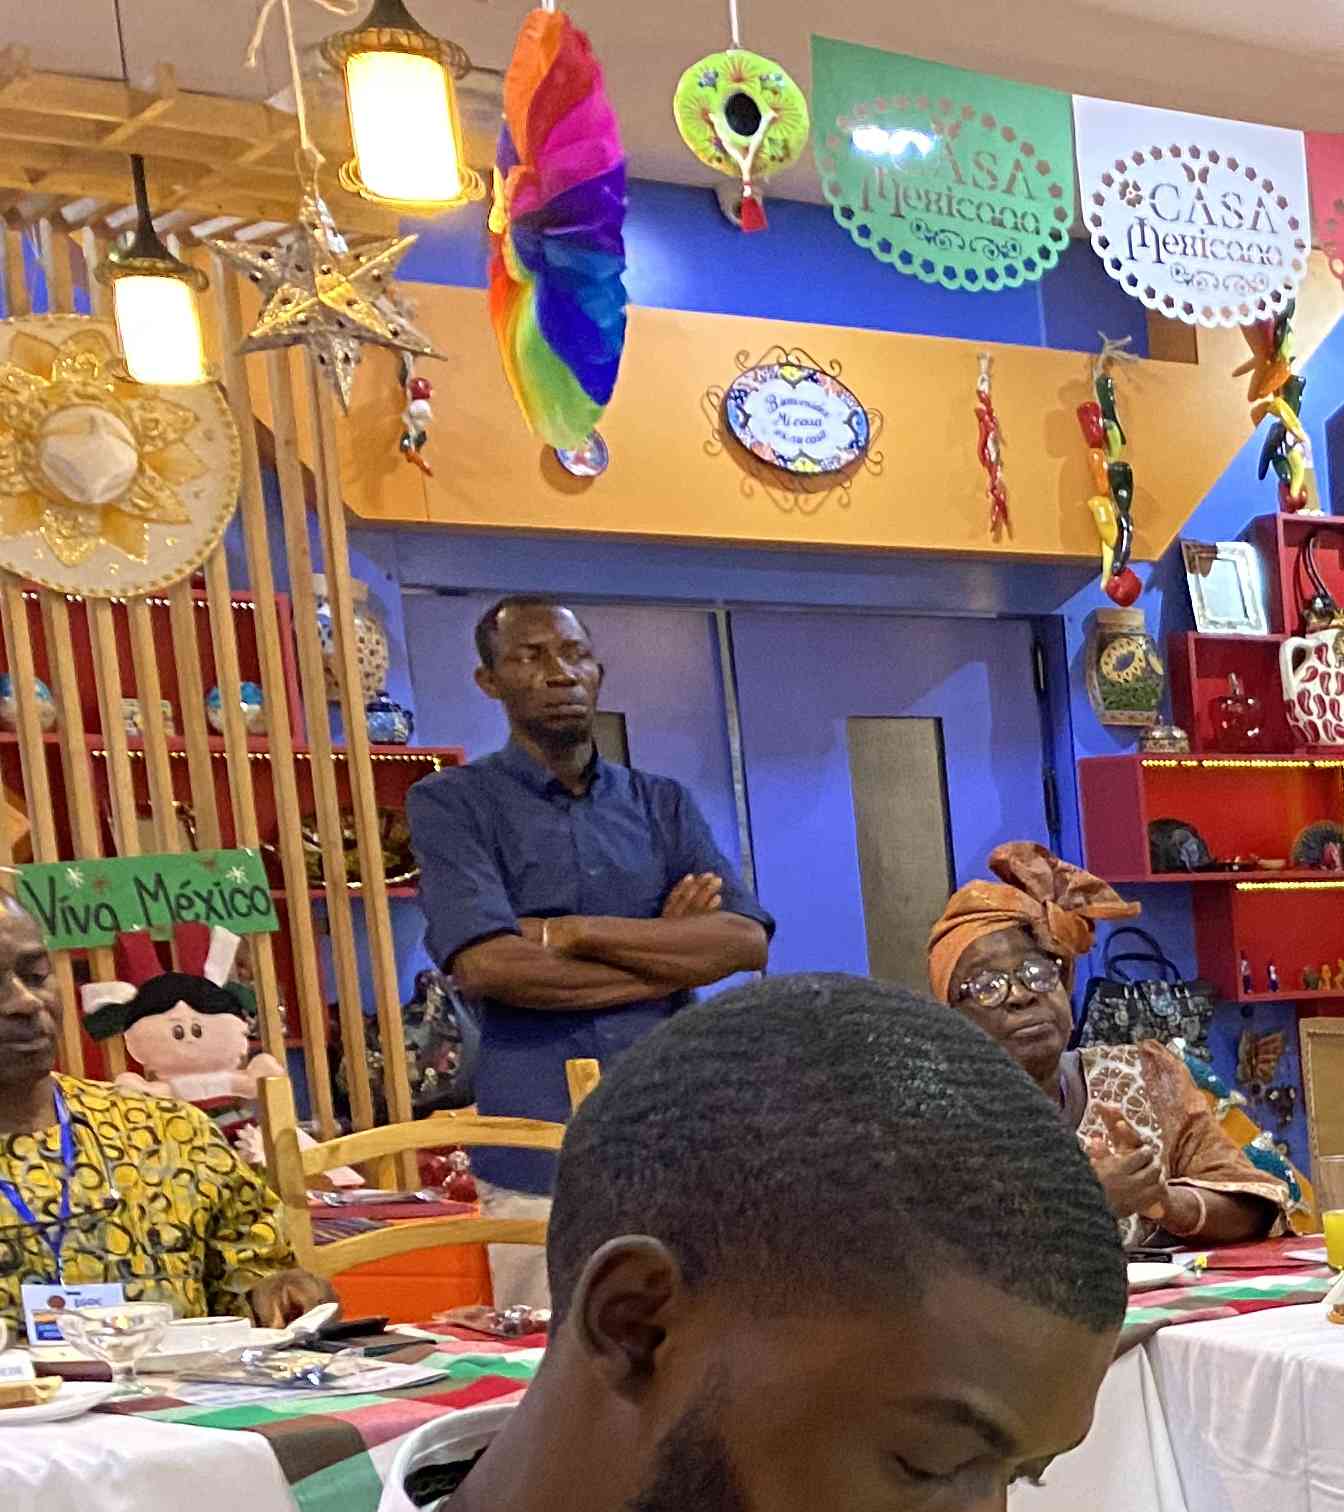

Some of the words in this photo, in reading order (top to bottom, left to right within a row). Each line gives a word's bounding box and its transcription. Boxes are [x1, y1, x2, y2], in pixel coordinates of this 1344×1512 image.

[1149, 182, 1278, 234] CASA
[1126, 215, 1283, 264] Mexicana
[133, 872, 272, 928] México
